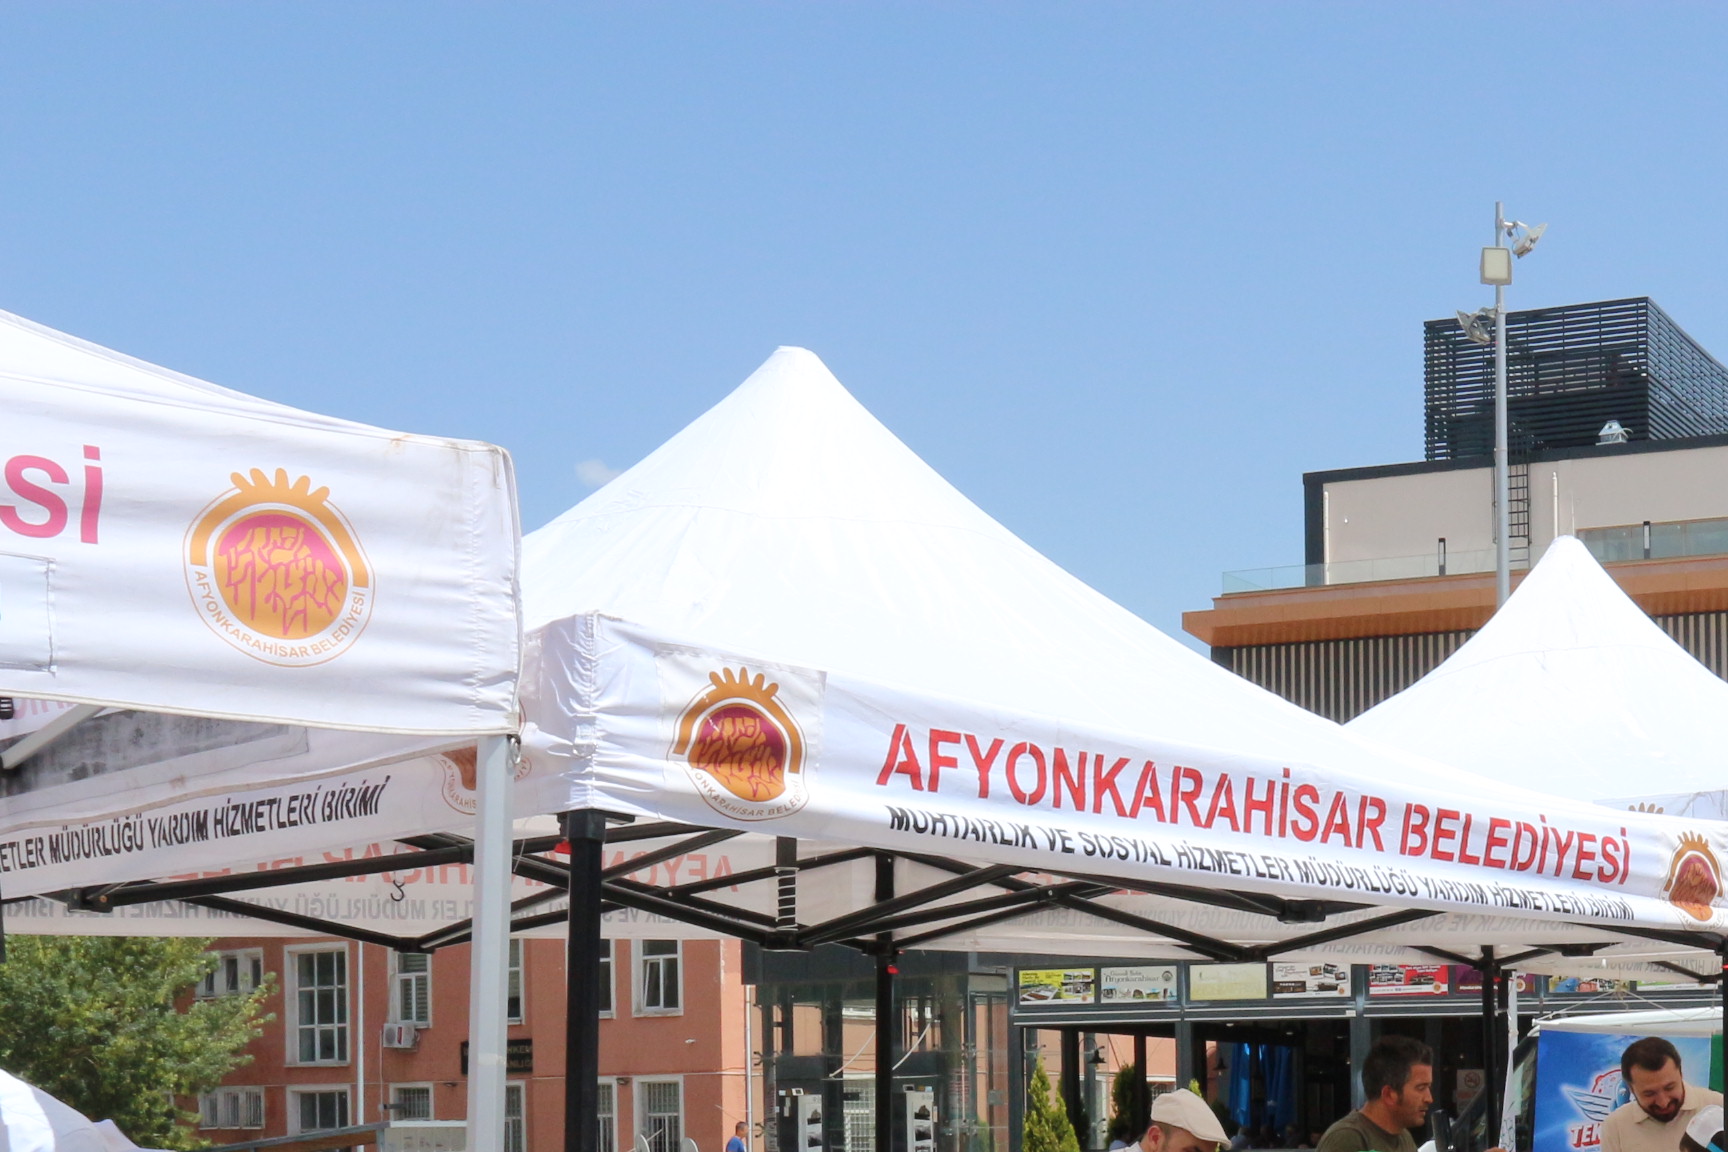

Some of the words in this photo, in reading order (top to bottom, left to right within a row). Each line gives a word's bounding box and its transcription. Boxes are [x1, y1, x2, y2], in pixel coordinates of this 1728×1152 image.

[194, 570, 310, 659] AFYONKARAHİSAR
[313, 589, 366, 656] BELEDİYESİ
[49, 813, 145, 865] MÜDÜRLÜĞÜ
[148, 809, 209, 847] YARDIM
[213, 784, 322, 840] HİZMETLERİ
[322, 775, 391, 824] BİRİMİ
[694, 771, 764, 817] ONKARAHİSAR
[876, 723, 1387, 852] AFYONKARAHİSAR
[1400, 803, 1631, 885] BELEDİYESİ
[886, 805, 1038, 850] MUHTARLIK
[1046, 825, 1076, 854] VE
[1083, 832, 1172, 866] SOSYAL
[1177, 839, 1296, 882] HİZMETLER
[1299, 856, 1419, 897] MÜDÜRLÜĞÜ
[1417, 875, 1489, 905] YARDIM
[1487, 881, 1586, 916] HİZMETLERİ
